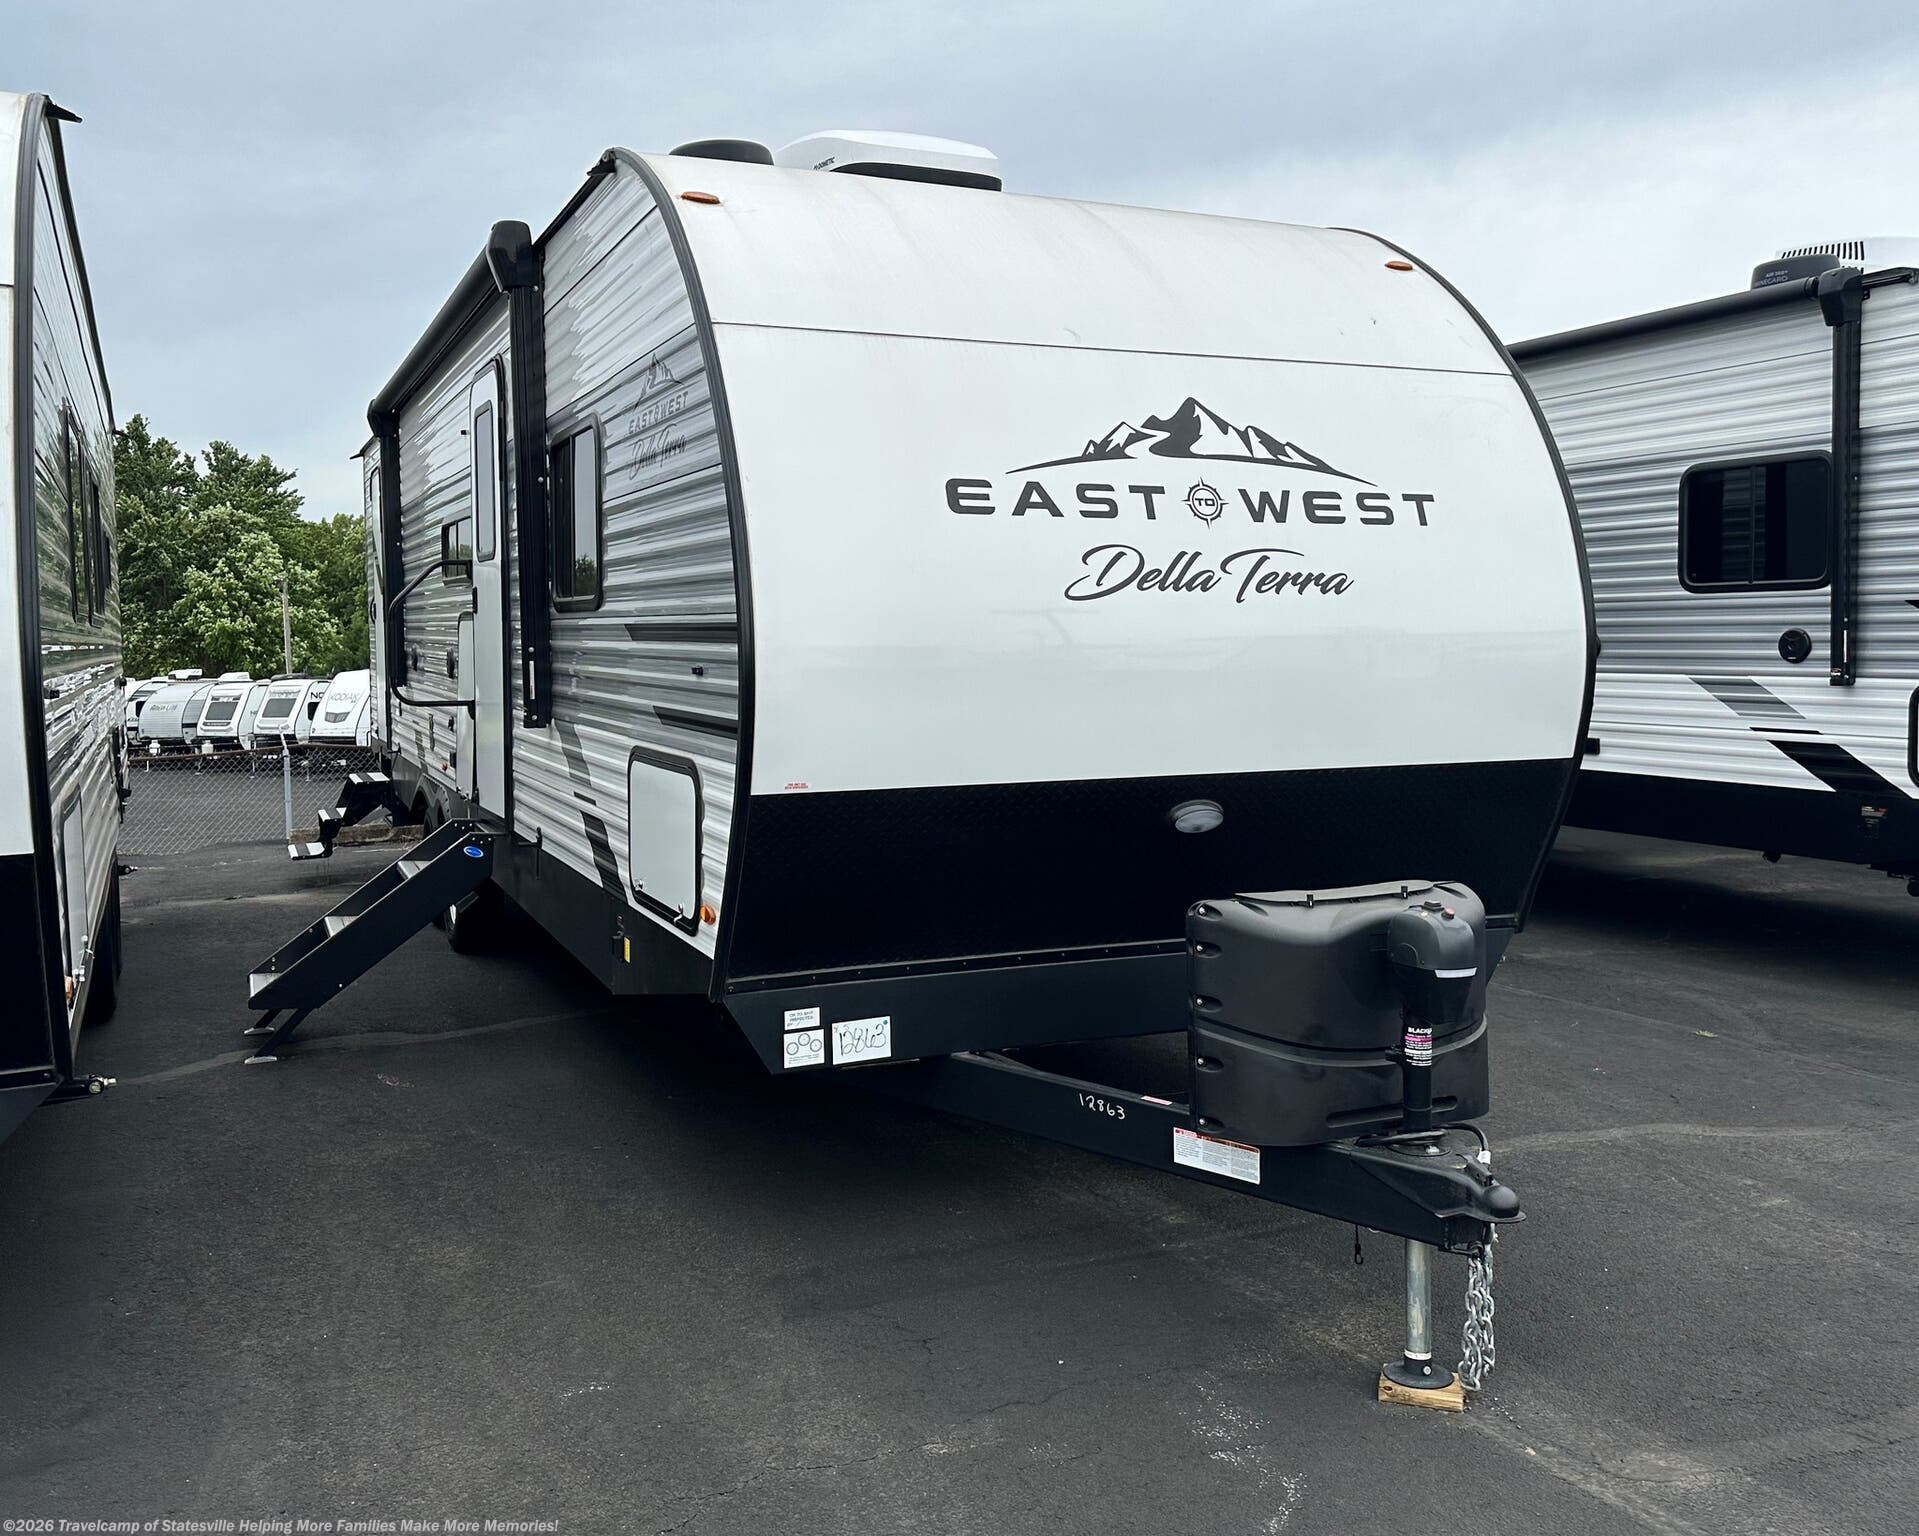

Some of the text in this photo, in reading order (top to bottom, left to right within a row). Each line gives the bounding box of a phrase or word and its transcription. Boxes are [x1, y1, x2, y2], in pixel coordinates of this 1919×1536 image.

[628, 391, 689, 435] EAST WEST
[656, 423, 688, 468] Terra
[944, 478, 1435, 527] EAST TO WEST
[1064, 544, 1355, 604] Della Terra
[839, 1023, 886, 1057] 12863
[1079, 1093, 1126, 1120] 12863
